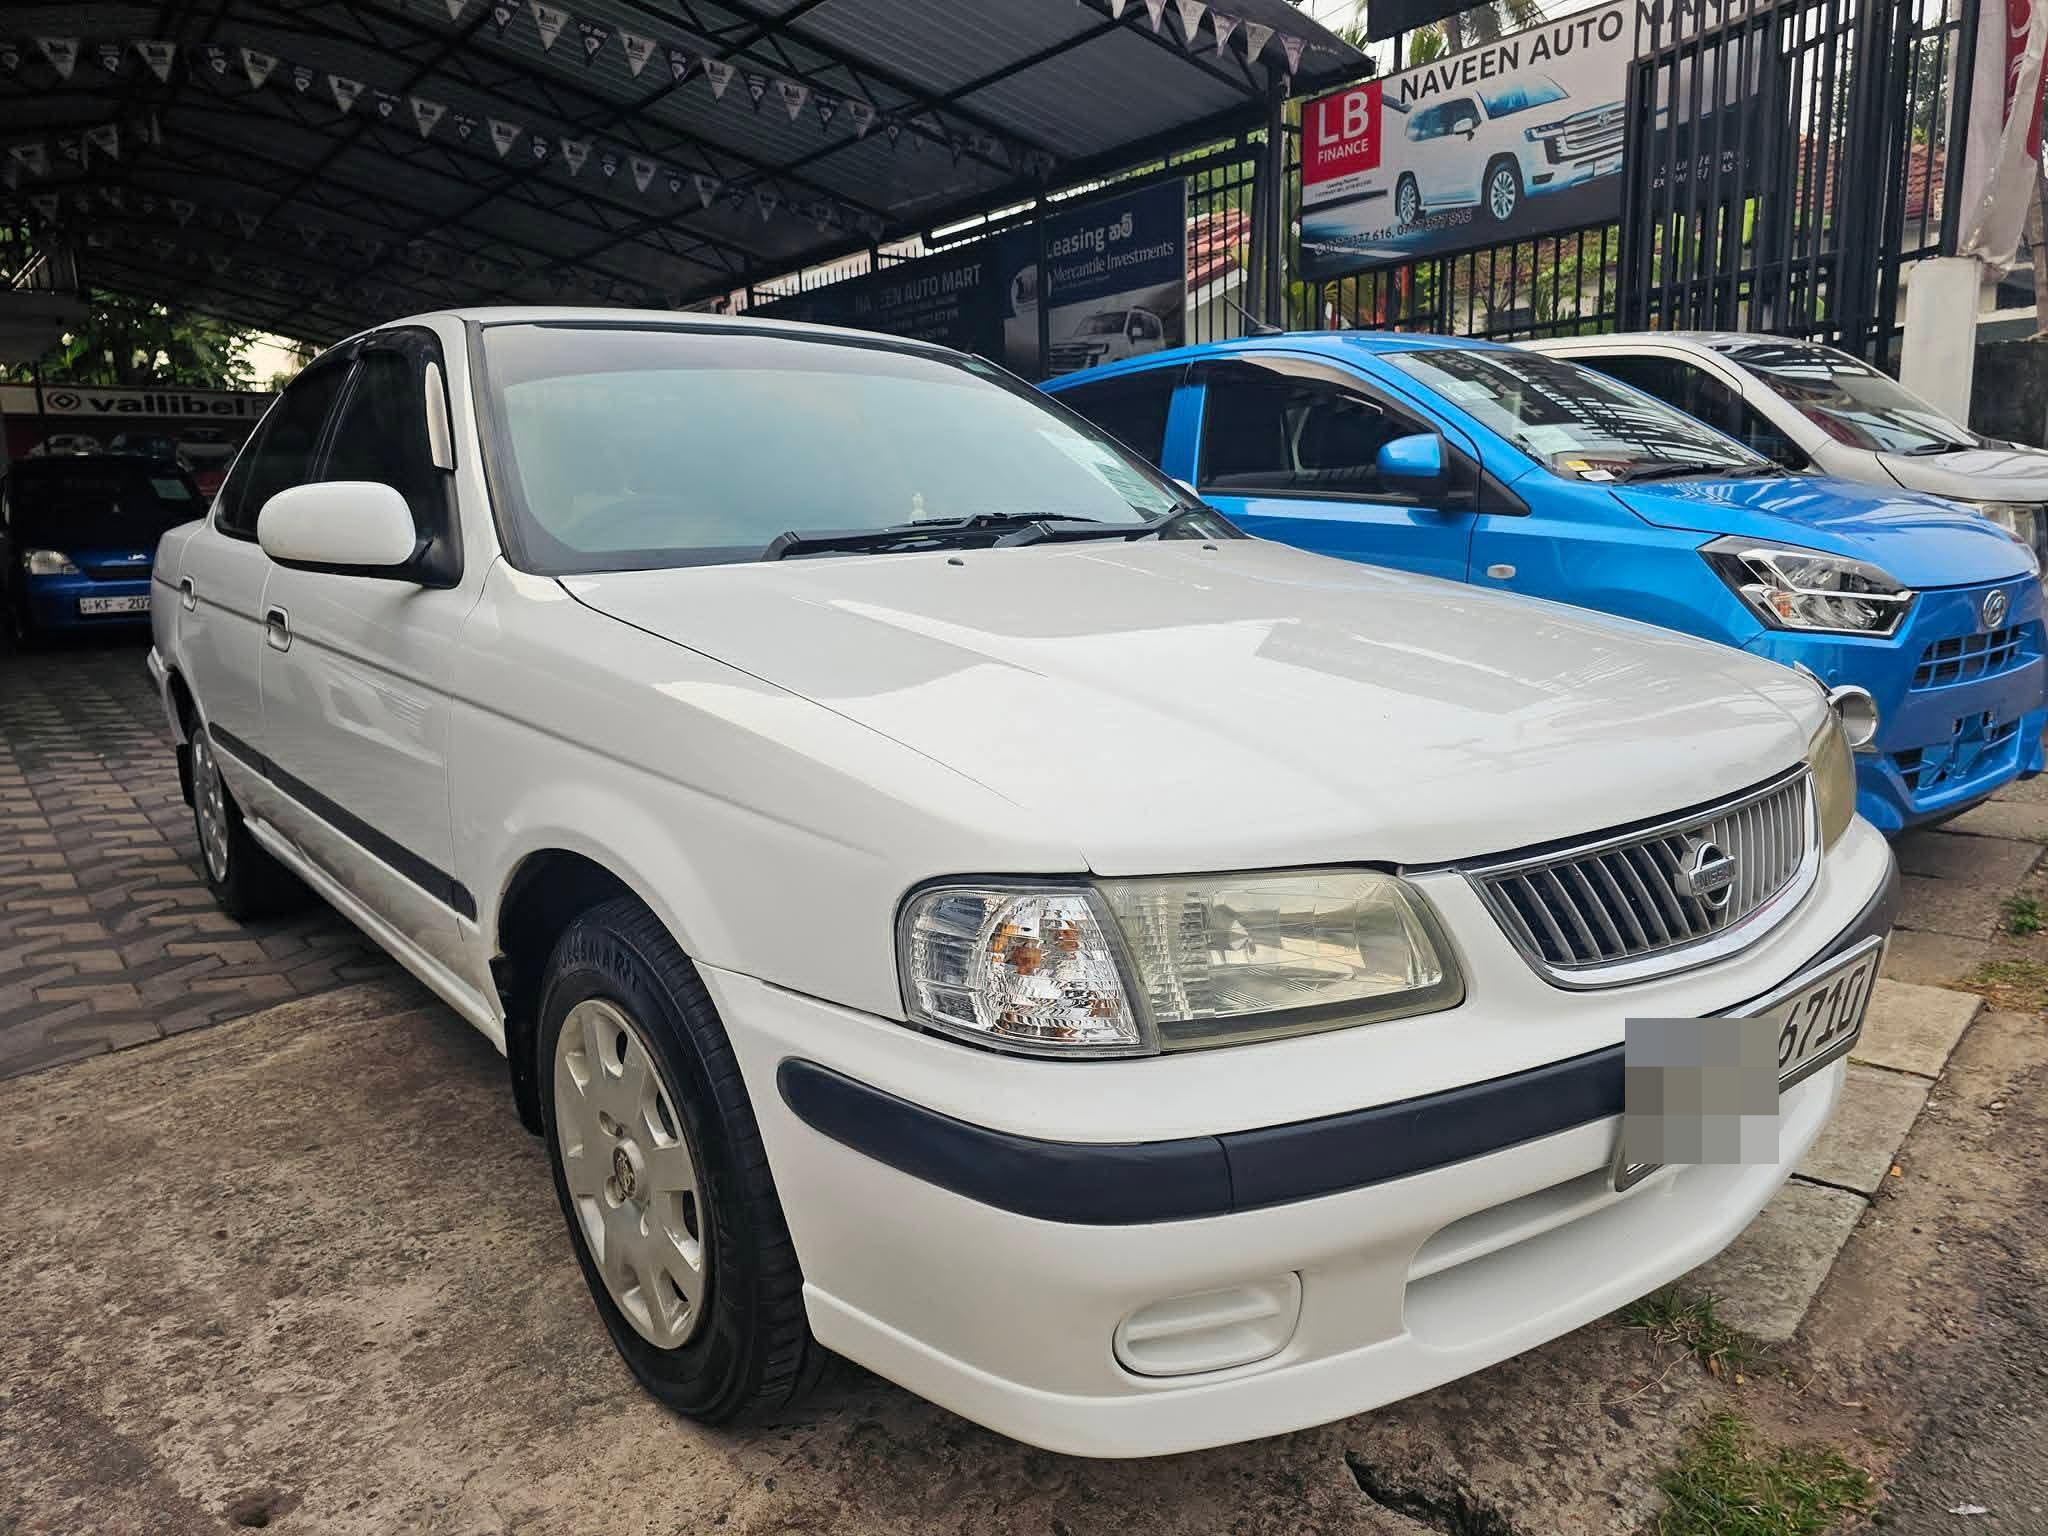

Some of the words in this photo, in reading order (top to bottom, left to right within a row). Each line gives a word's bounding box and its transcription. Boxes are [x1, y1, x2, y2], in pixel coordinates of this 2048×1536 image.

[1400, 42, 1519, 104] NAVEEN
[1528, 10, 1624, 65] AUTO
[1318, 91, 1369, 146] LB
[1317, 138, 1369, 165] FINANCE
[1047, 226, 1106, 259] Leasing
[1054, 256, 1105, 281] Mercantile
[1106, 240, 1176, 271] Investments
[904, 276, 938, 304] AUTO
[941, 263, 983, 294] MART
[90, 397, 244, 415] vallibel
[1778, 964, 1867, 1069] 6710
